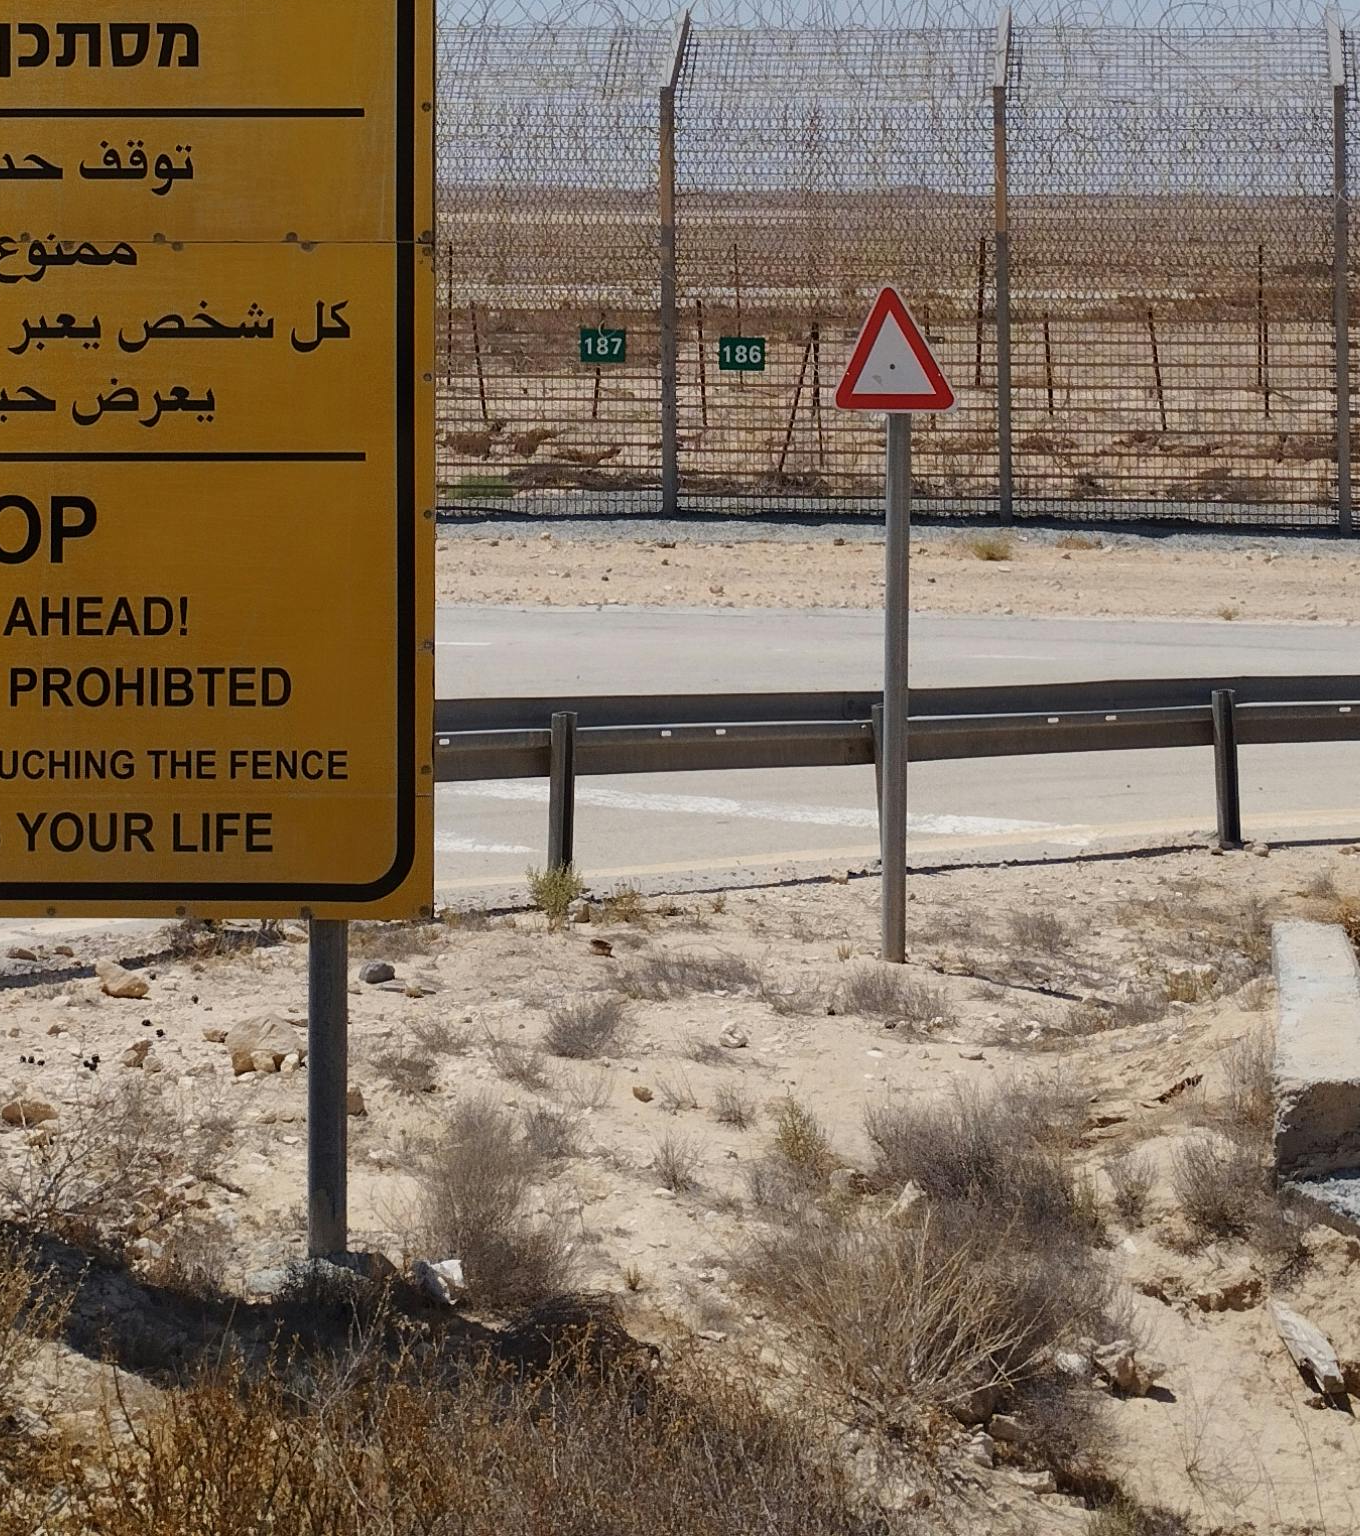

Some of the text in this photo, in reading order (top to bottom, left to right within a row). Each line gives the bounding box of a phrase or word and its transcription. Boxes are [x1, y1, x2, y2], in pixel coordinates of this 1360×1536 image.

[78, 140, 195, 196] توقف
[7, 313, 102, 355] يعبر
[118, 300, 275, 353] شخص
[290, 300, 352, 353] كل
[584, 337, 623, 355] 187
[723, 345, 762, 363] 186
[71, 377, 216, 428] يعرض
[2, 595, 191, 637] AHEAD!
[9, 666, 292, 708] PROHIBTED
[146, 749, 217, 781] THE
[229, 749, 349, 781] FENCE
[14, 811, 156, 853] YOUR
[172, 811, 274, 853] LIFE
